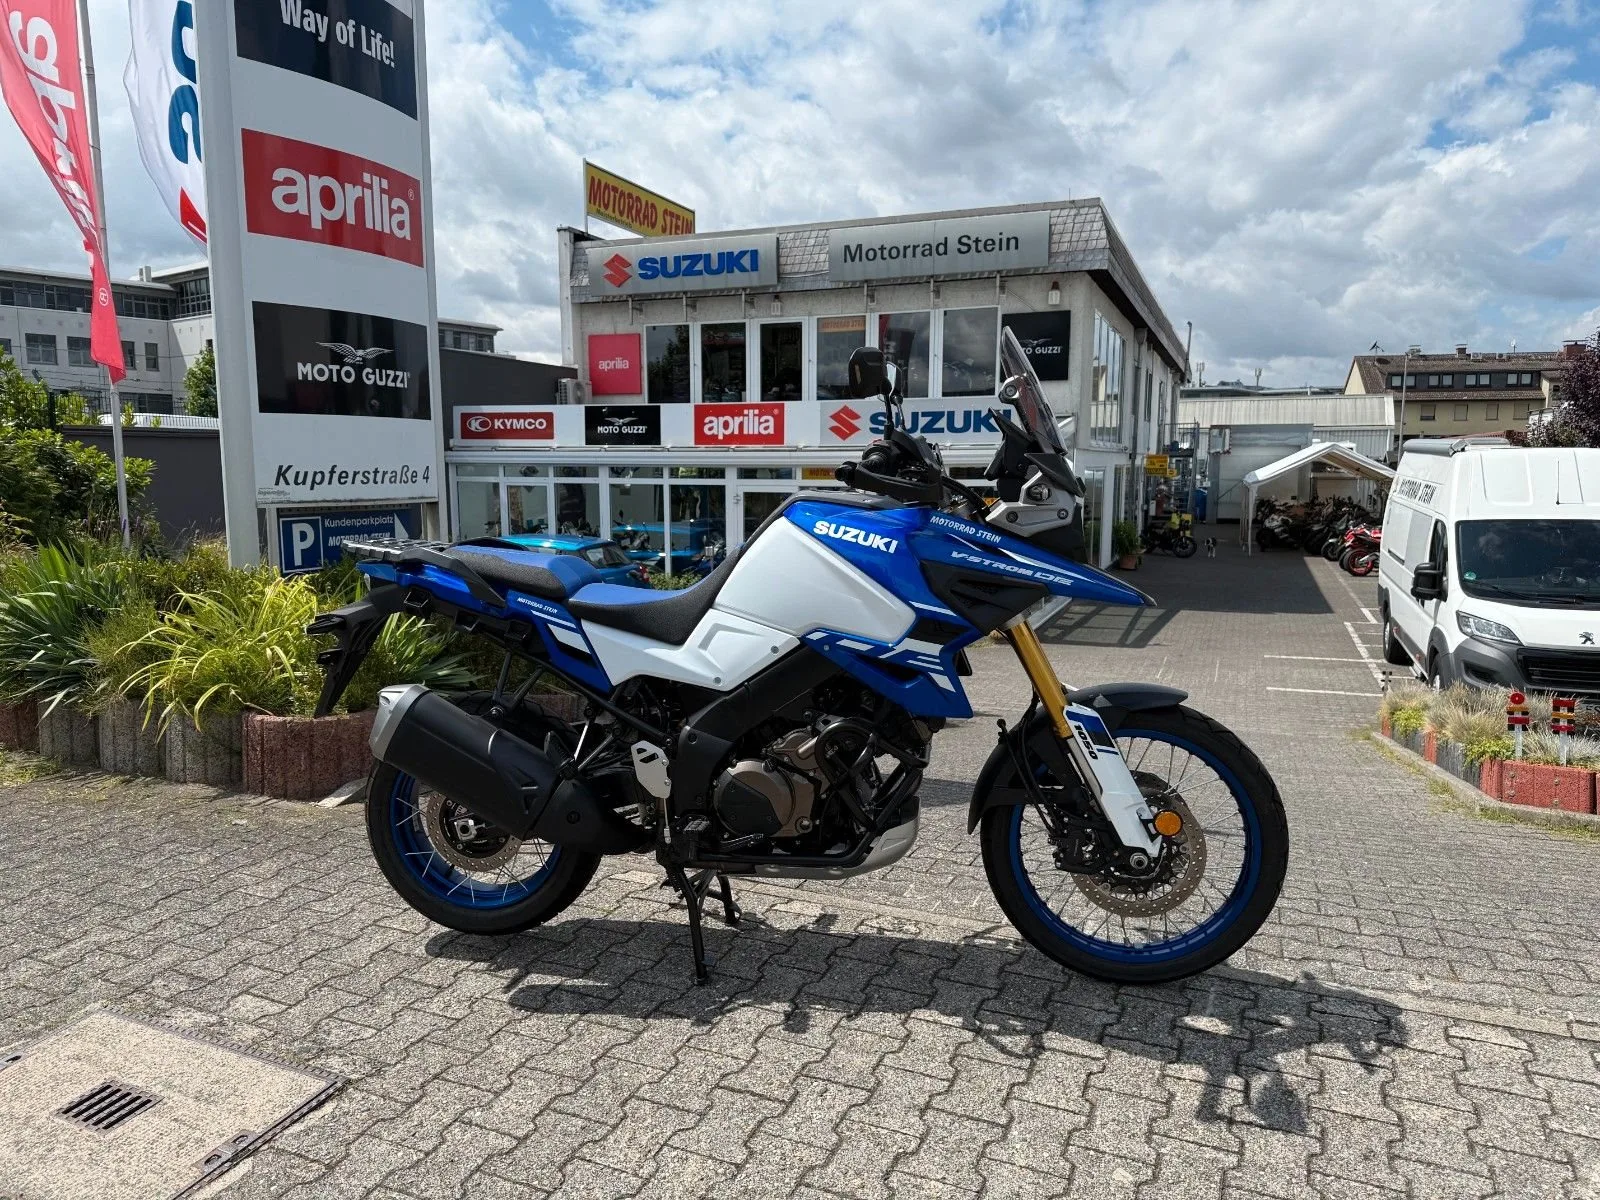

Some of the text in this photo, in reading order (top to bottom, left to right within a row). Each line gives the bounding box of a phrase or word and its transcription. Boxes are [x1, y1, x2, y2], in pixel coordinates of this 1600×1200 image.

[280, 0, 395, 68] Way of Life!
[271, 167, 411, 241] aprilia
[589, 175, 693, 236] MOTORRAD STEIN
[843, 232, 1019, 263] Motorrad Stein
[638, 249, 759, 280] SUZUKI
[599, 357, 629, 371] aprilia
[1035, 346, 1061, 354] GUZZI
[297, 362, 408, 389] MOTO GUZZI
[494, 418, 547, 430] KYMCO
[597, 425, 646, 434] MOTO GUZZI
[703, 409, 775, 440] aprilia
[274, 464, 430, 491] Kupferstraße 4
[324, 515, 394, 528] Kundenparkplatz
[813, 520, 899, 554] SUZUKI
[930, 515, 1001, 544] MOTORRAD STEIN
[292, 522, 315, 566] P
[1074, 724, 1099, 760] 1050
